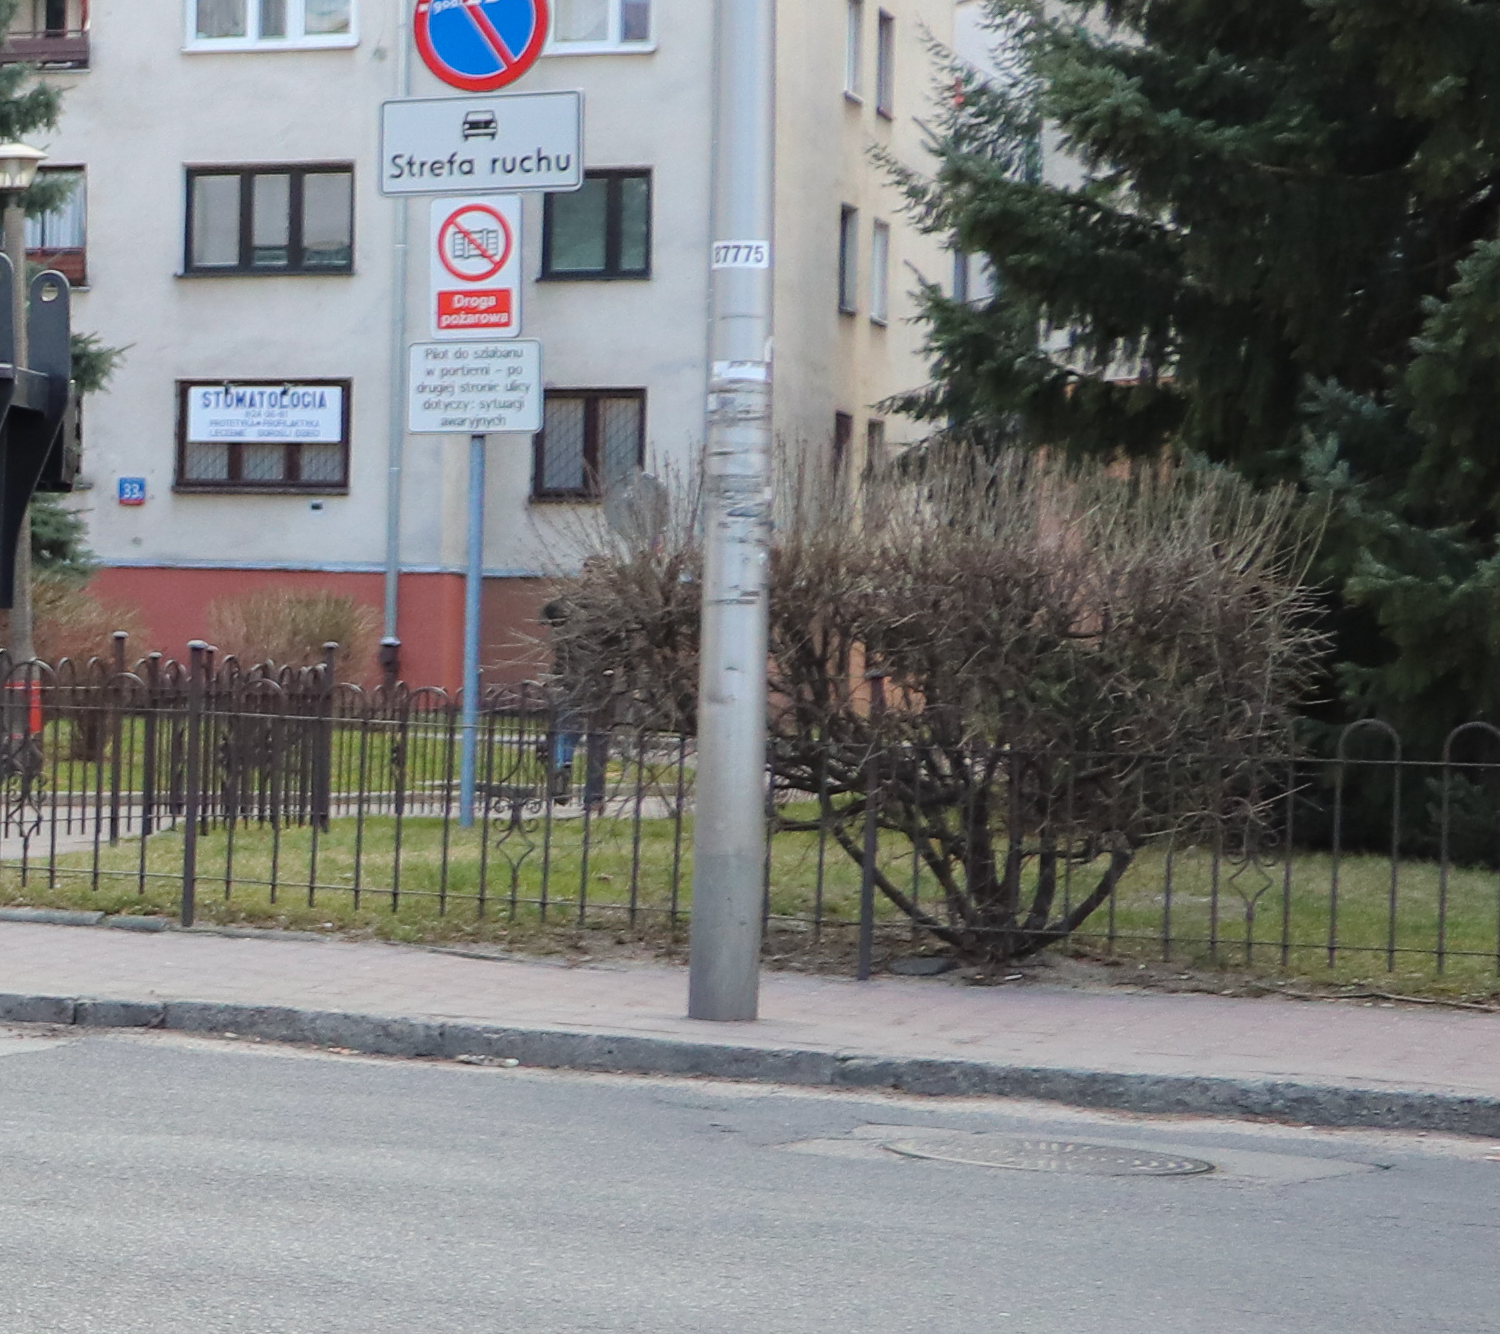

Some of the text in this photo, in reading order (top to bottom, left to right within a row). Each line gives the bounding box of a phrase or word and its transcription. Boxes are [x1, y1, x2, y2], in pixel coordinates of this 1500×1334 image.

[389, 146, 571, 179] Strefa ruchu
[452, 294, 497, 311] Droga
[441, 311, 509, 327] pożarowa
[425, 348, 449, 360] Pilot
[454, 347, 469, 359] do
[508, 367, 523, 378] po
[416, 381, 456, 396] drugiej
[505, 380, 531, 394] ulicy
[201, 390, 328, 408] STOMATOLOGIA
